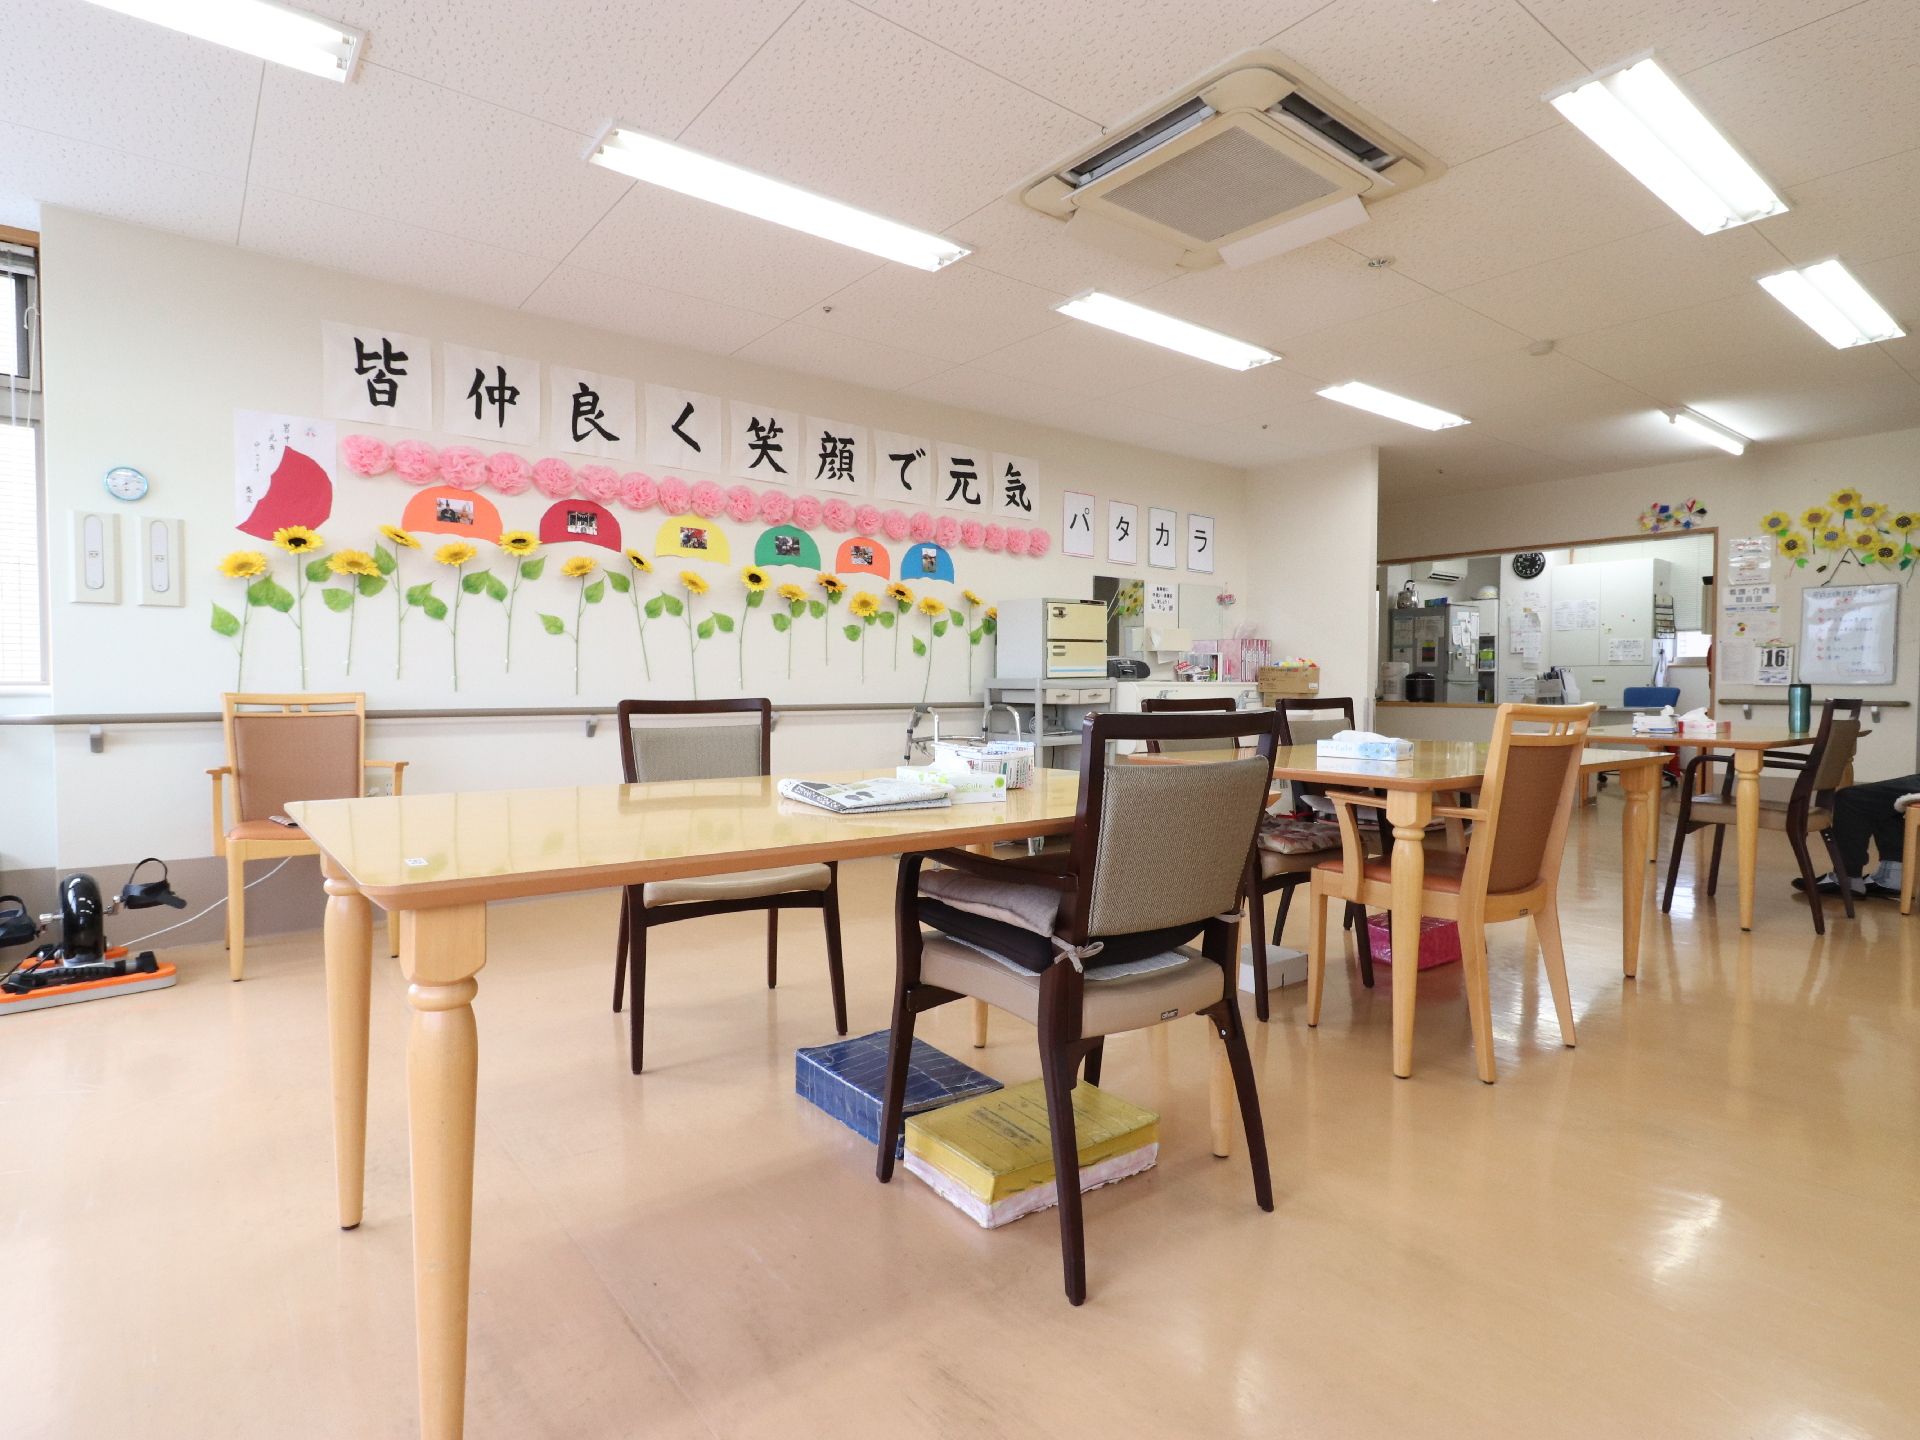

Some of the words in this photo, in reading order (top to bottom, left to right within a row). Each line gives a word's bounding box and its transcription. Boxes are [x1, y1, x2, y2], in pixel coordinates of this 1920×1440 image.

[1070, 507, 1208, 552] パタカラ
[1765, 649, 1785, 667] 16
